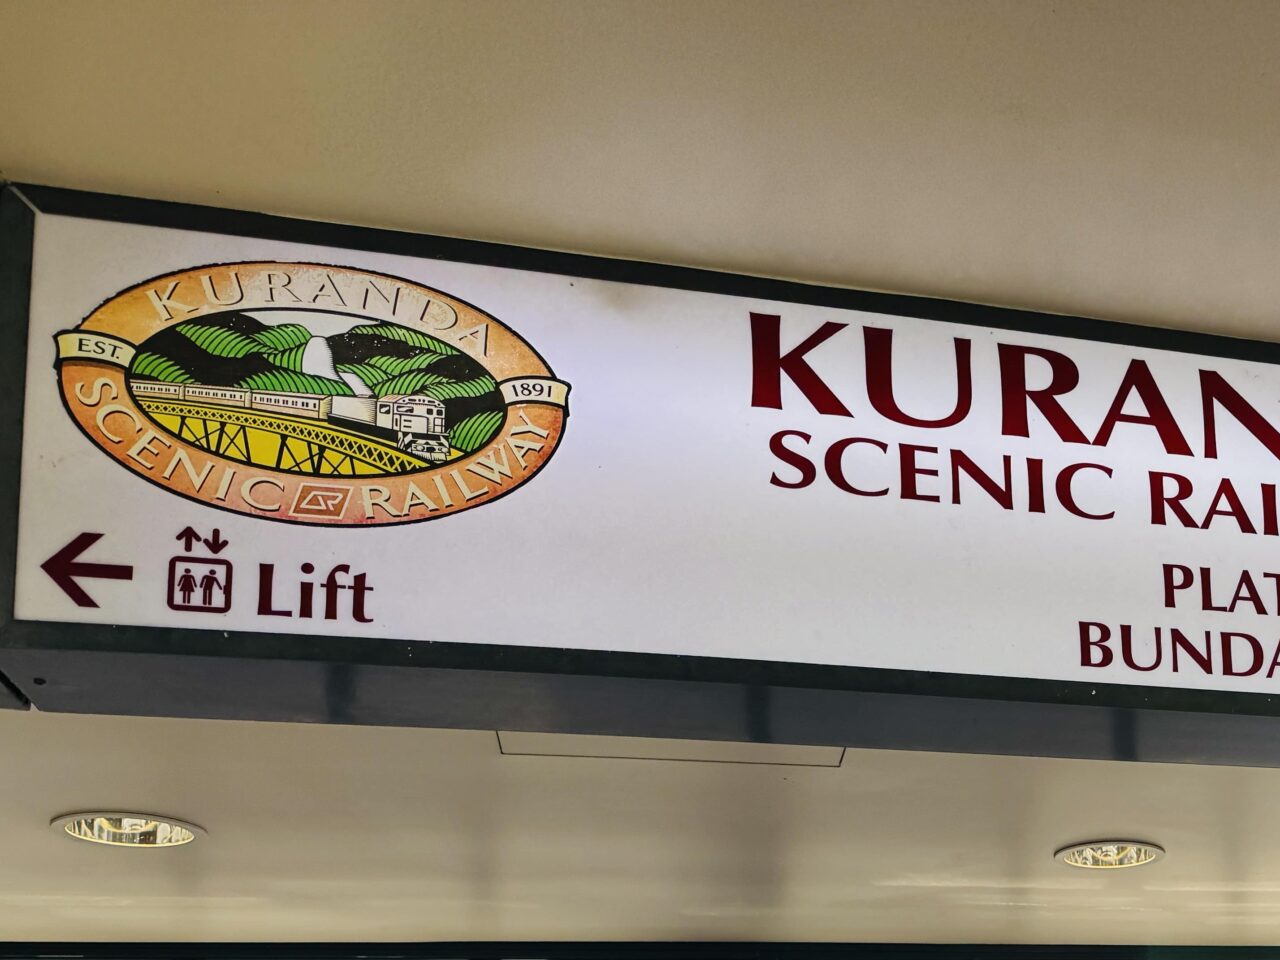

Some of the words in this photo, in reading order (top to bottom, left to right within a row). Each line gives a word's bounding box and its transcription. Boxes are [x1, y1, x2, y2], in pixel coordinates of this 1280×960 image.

[77, 338, 121, 359] EST.
[146, 269, 491, 358] KURANDA
[511, 382, 552, 398] 1891
[75, 377, 285, 511] SCENIC
[361, 410, 550, 518] RAILWAY
[769, 430, 1115, 520] SCENIC
[257, 562, 374, 623] Lift
